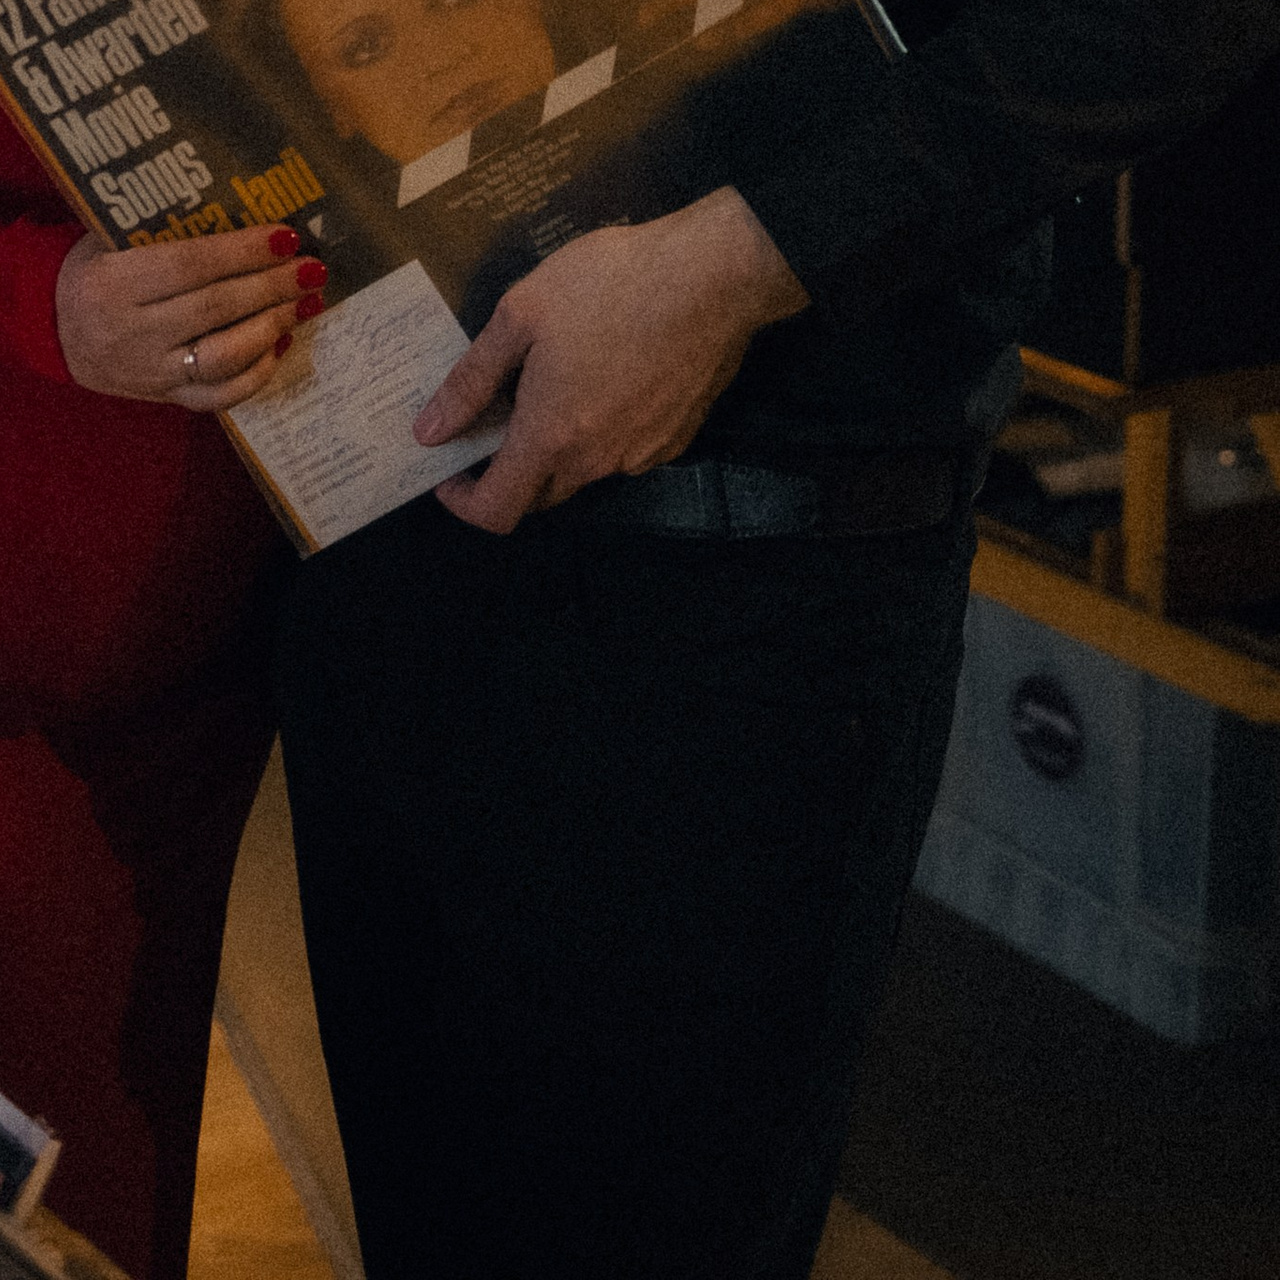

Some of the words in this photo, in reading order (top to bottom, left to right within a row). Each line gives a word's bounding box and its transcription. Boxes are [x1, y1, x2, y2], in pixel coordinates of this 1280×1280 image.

[12, 54, 63, 114] &
[49, 85, 171, 174] Movie
[90, 140, 214, 230] Songs
